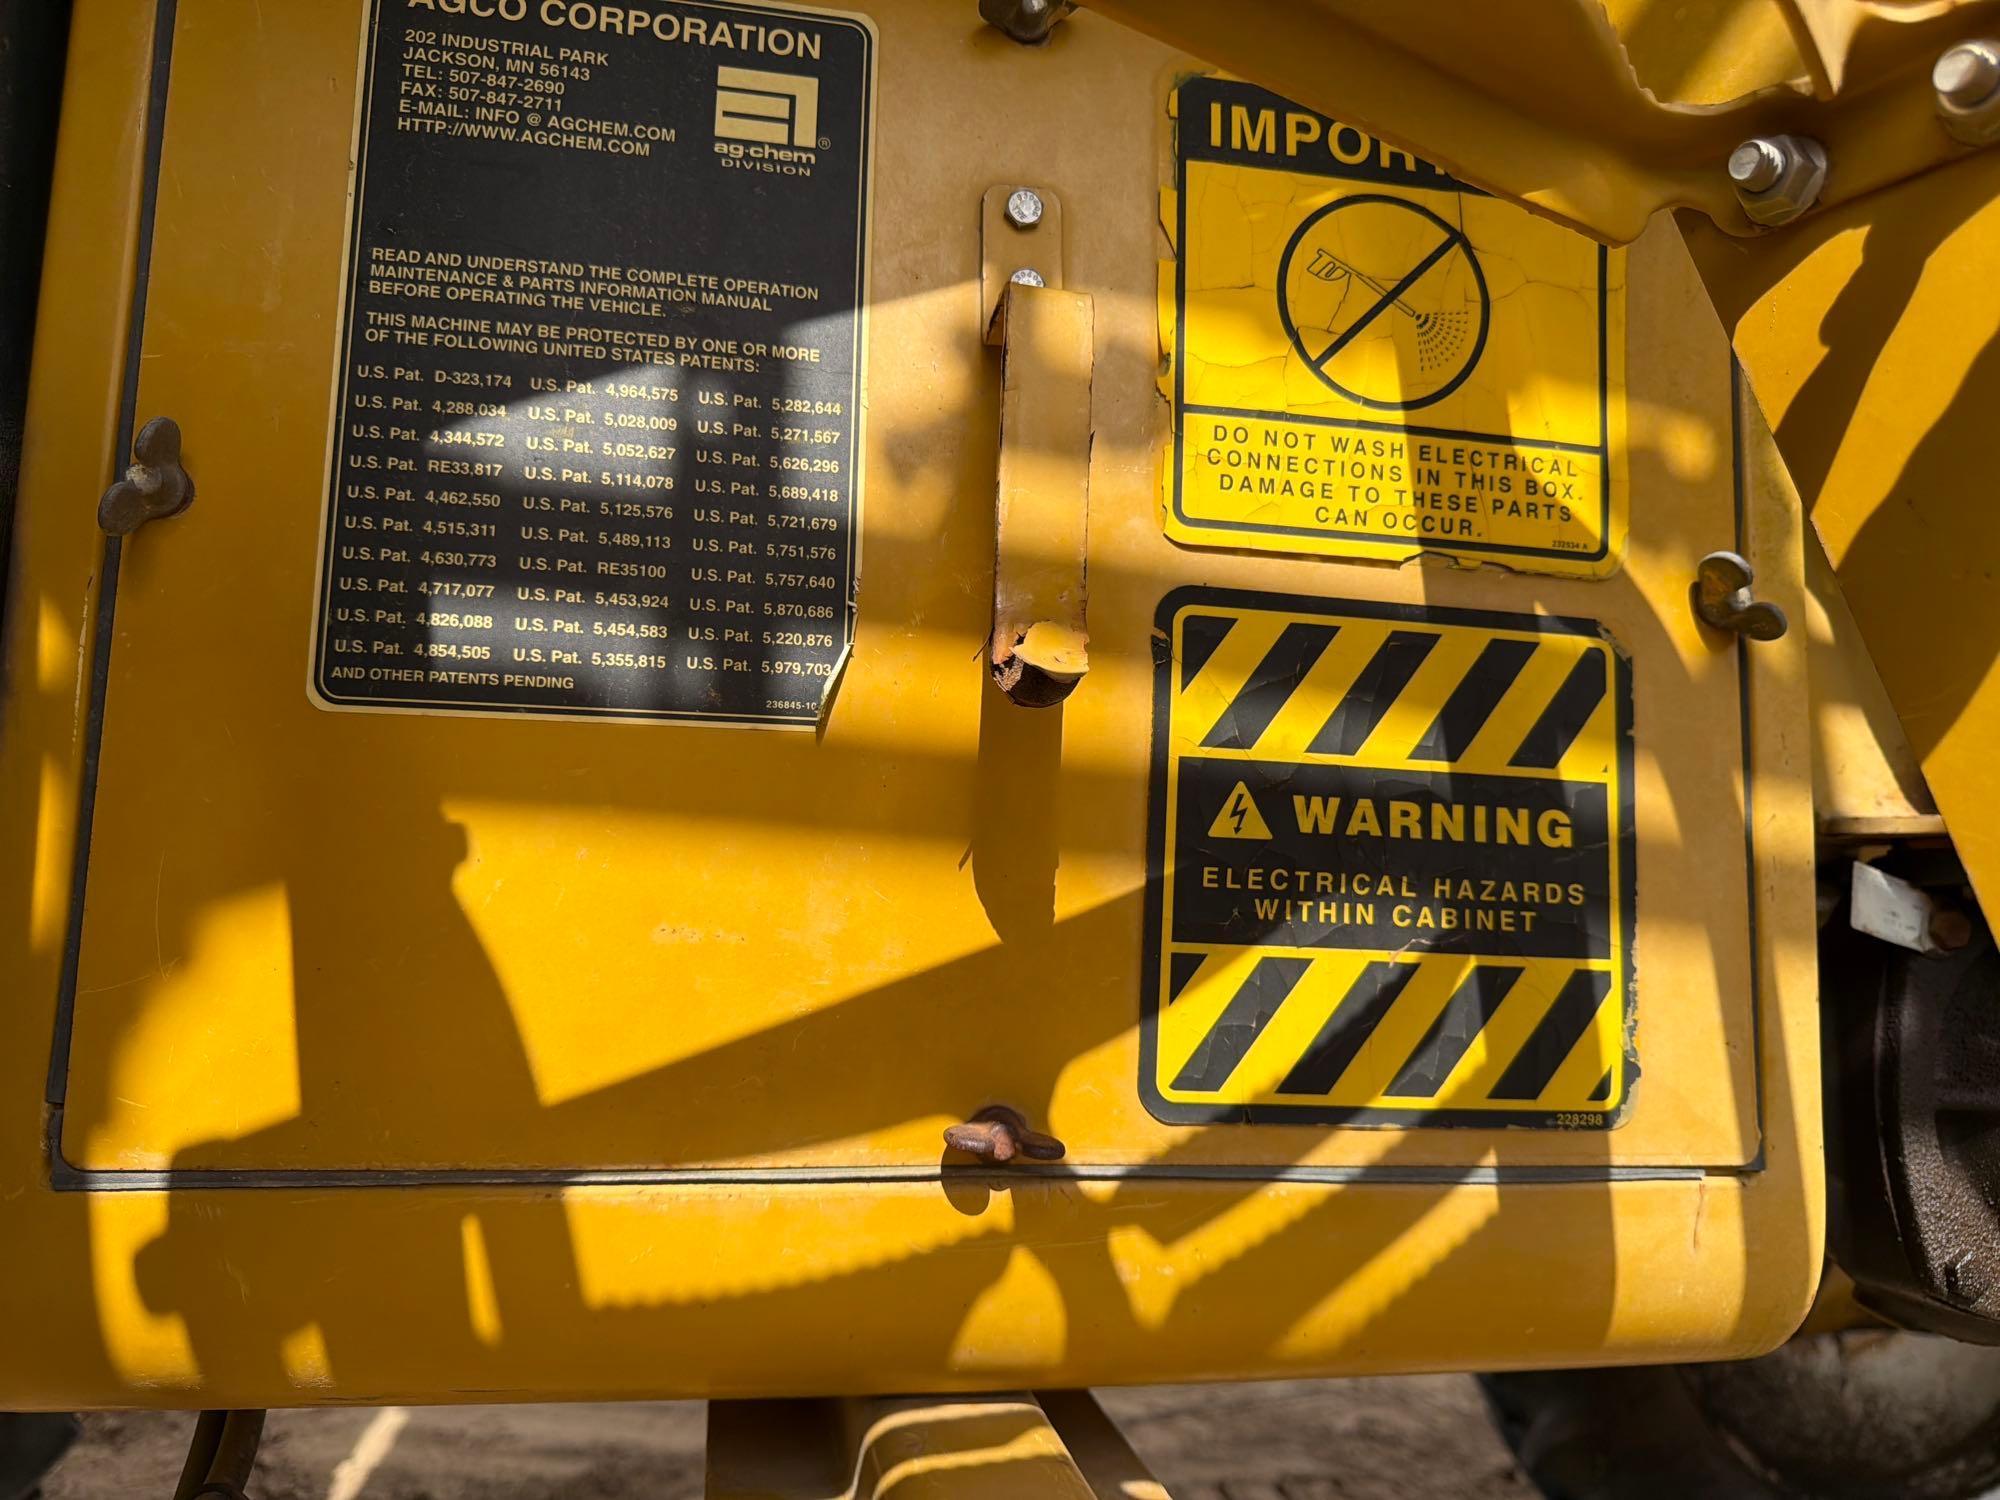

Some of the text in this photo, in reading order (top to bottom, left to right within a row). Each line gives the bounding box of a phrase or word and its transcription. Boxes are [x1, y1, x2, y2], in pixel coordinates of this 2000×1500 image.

[540, 0, 821, 60] CORPORATION
[405, 29, 608, 66] 202 INDUSTRIAL PARK
[403, 47, 590, 81] JACKSON, MN 56143
[402, 63, 565, 95] TEL: 507-847-2690
[401, 81, 561, 112] FAX: 507-847-2711
[399, 99, 675, 142] E-MAIL: INFO @ AGCHEM.COM
[398, 117, 649, 156] HTTP://WWW.AGCHEM.COM
[1211, 102, 1445, 175] IMPOR
[721, 158, 810, 176] DIVISION
[372, 247, 818, 300] READ AND UNDERSTAND THE COMPLETE OPERATION
[369, 280, 666, 317] BEFORE OPERATING THE VEHICLE.
[371, 264, 772, 311] MAINTENANCE & PARTS INFORMATION MANUAL
[366, 311, 820, 362] THIS MACHINE MAY BE PROTECTED BY ONE OR MORE
[365, 328, 759, 373] OF THE FOLLOWING UNITED STATES PATENTS:
[358, 365, 512, 388] U.S. Pat. D-323,174
[528, 406, 677, 431] U.S. Pat. 5,028,009
[526, 436, 676, 460] U.S. Pat. 5,052,627
[1214, 425, 1577, 477] DO NOT WASH ELECTRICAL
[697, 450, 839, 473] U.S. Pat. 5,626,296
[525, 466, 673, 489] U.S. Pat. 5,114,078
[1207, 448, 1583, 501] CONNECTIONS IN THIS BOX.
[348, 485, 501, 507] U.S. Pat. 4,462,550
[695, 479, 838, 502] U.S. Pat. 5,689,418
[1220, 474, 1571, 522] DAMAGE TO THESE PARTS
[523, 497, 673, 519] U.S. Pat. 5,125,576
[345, 516, 495, 536] U.S. Pat. 4,515,311
[694, 509, 837, 531] U.S. Pat. 5,721,679
[1315, 506, 1482, 537] CAN OCCUR.
[521, 526, 671, 549] U.S. Pat. 5,489,113
[693, 538, 836, 560] U.S. Pat. 5,751,576
[342, 546, 496, 568] U.S. Pat. 4,630,773
[520, 557, 666, 578] U.S. Pat. RE35100
[340, 577, 495, 598] U.S. Pat. 4,717,077
[691, 568, 835, 589] U.S. Pat. 5,757,640
[517, 587, 669, 608] U.S. Pat. 5,453,924
[690, 598, 833, 619] U.S. Pat. 5,870,686
[337, 608, 493, 629] U.S. Pat. 4,826,088
[515, 617, 667, 639] U.S. Pat. 5,454,583
[688, 627, 832, 647] U.S. Pat. 5,220,876
[335, 639, 490, 660] U.S. Pat. 4,854,505
[513, 648, 666, 669] U.S. Pat. 5,355,815
[331, 667, 574, 689] AND OTHER PATENTS PENDING
[687, 656, 831, 677] U.S. Pat. 5,979,703
[1293, 795, 1572, 848] WARNING
[1203, 867, 1583, 905] ELECTRICAL HAZARDS
[1254, 898, 1536, 932] WITHIN CABINET
[1556, 1113, 1603, 1126] 228298
